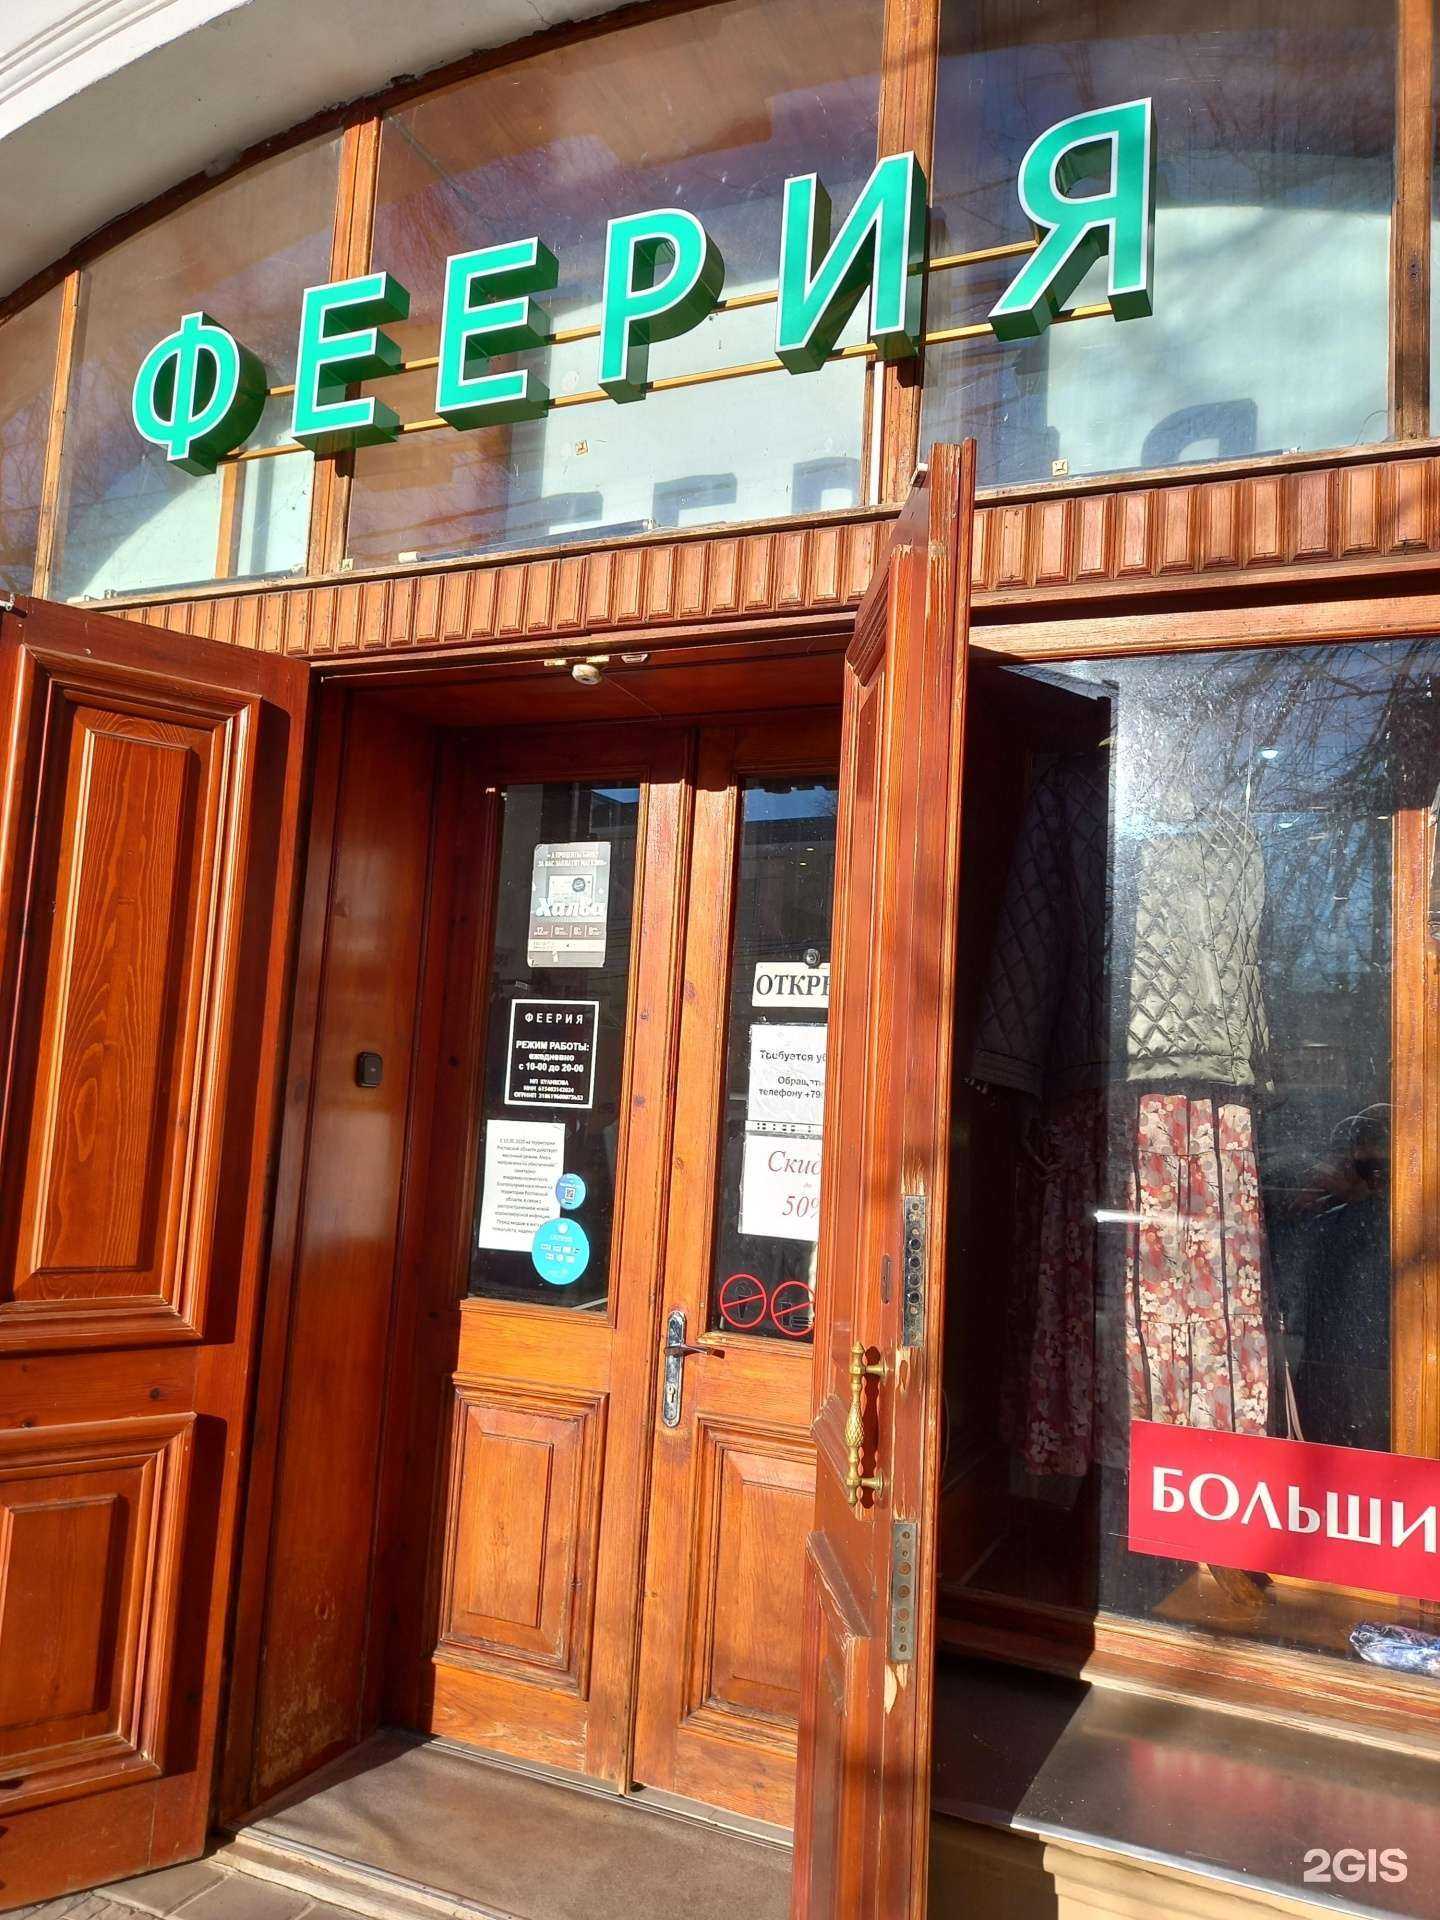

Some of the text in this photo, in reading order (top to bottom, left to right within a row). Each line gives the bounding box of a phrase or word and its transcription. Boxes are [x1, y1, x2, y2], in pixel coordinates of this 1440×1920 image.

[131, 97, 1153, 472] ФЕЕРИЯ
[524, 1012, 584, 1024] ФЕЕРИЯ
[515, 1040, 590, 1052] РЕЖИМ РАБОТЫ:
[528, 1053, 575, 1062] ежедневно
[525, 1062, 548, 1071] 10-00
[548, 1064, 560, 1073] до
[561, 1063, 584, 1073] 20-00
[1152, 1465, 1437, 1554] БОЛЬШИ
